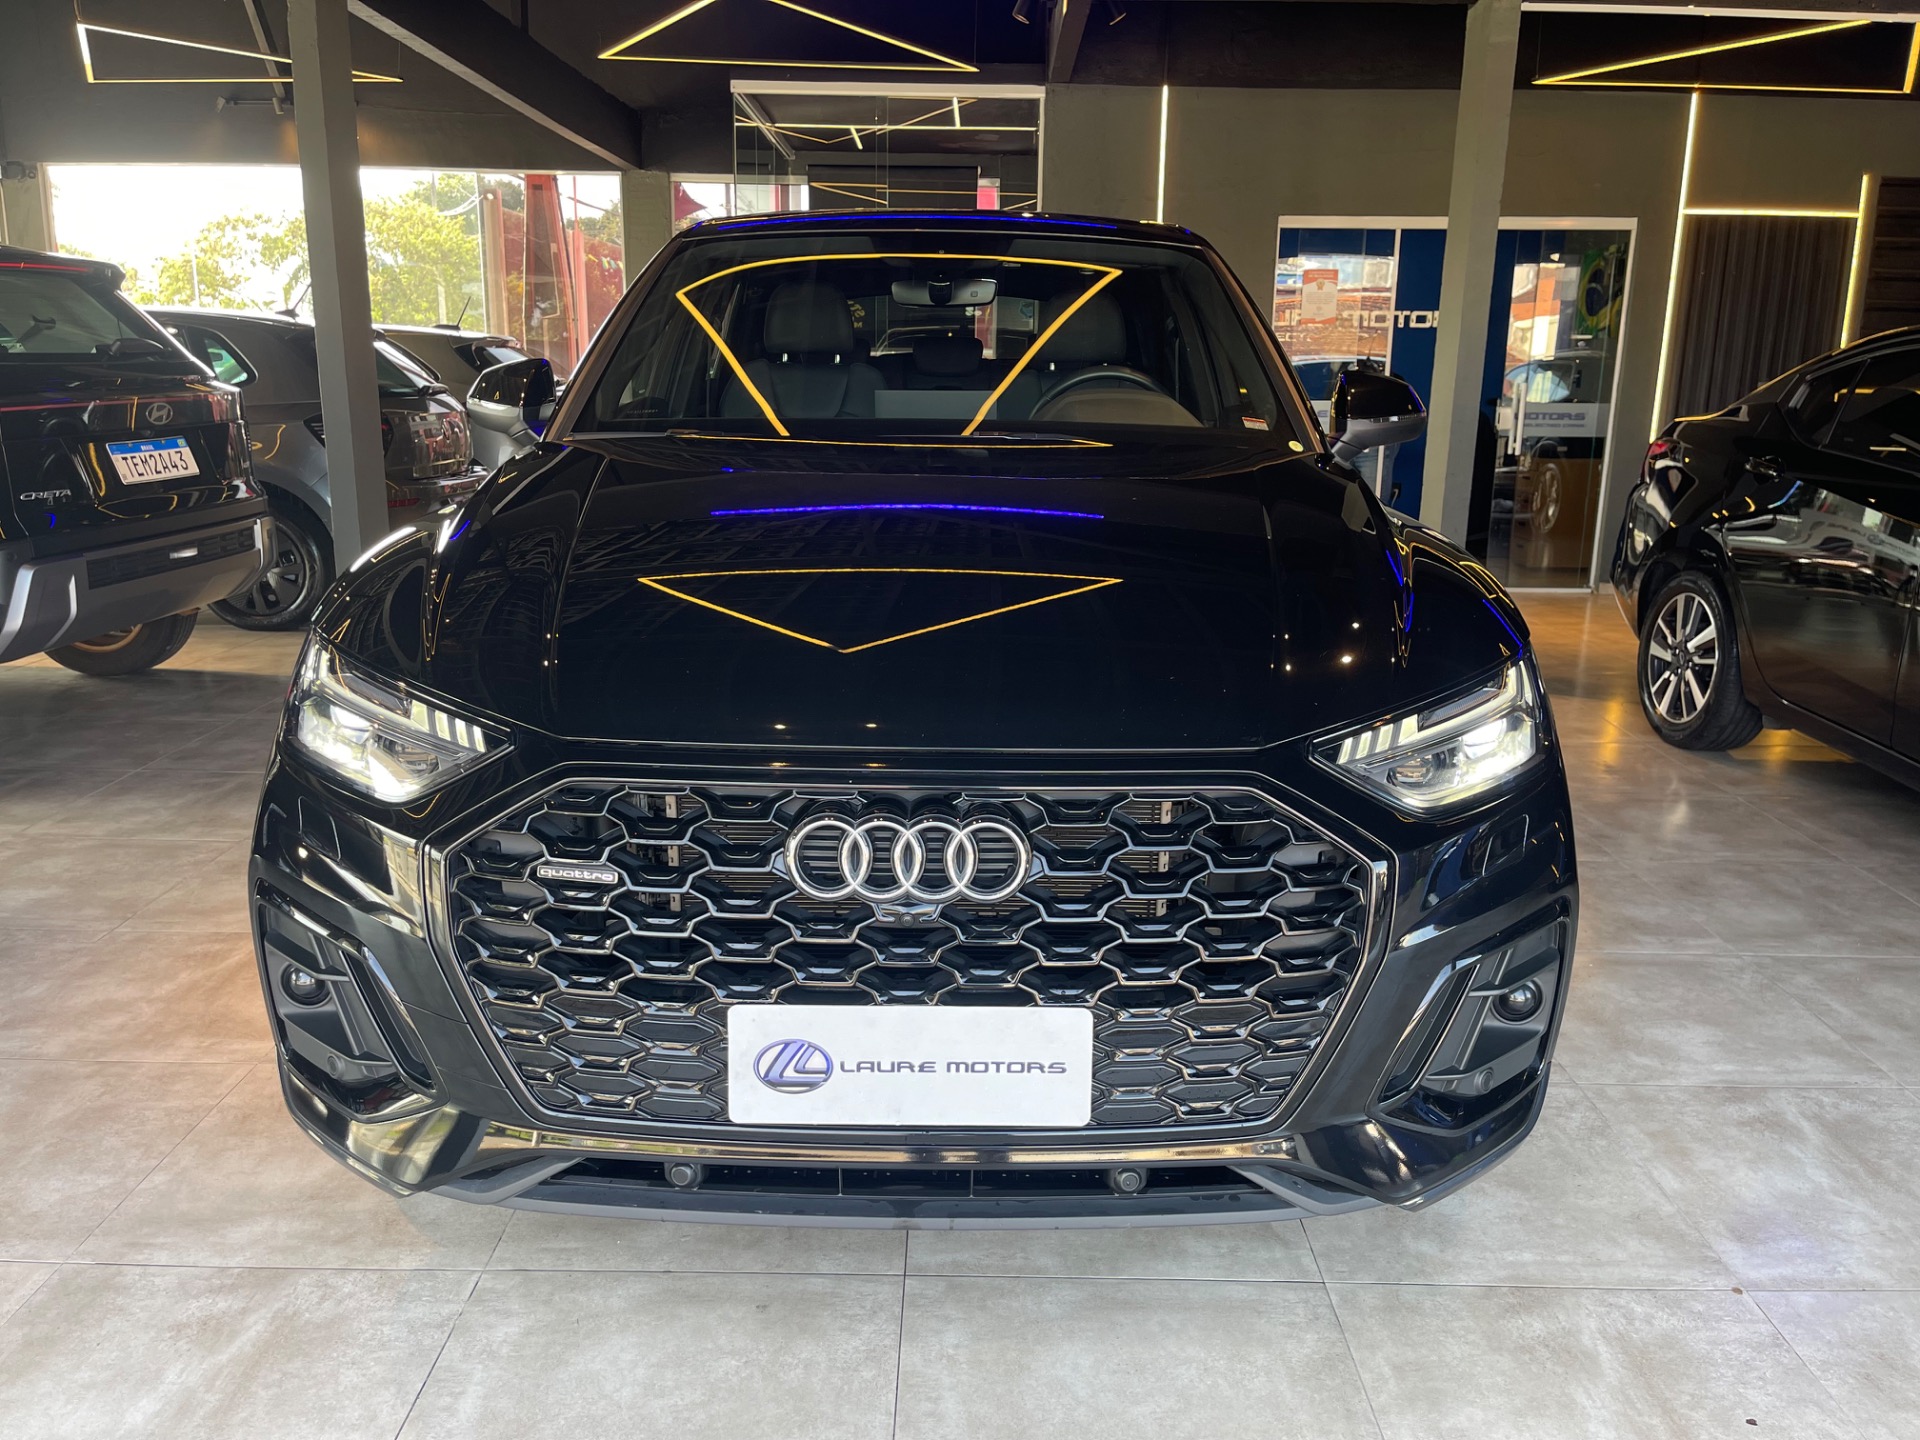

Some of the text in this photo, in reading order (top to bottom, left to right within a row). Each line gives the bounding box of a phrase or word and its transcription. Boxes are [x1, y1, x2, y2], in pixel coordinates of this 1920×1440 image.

[121, 450, 189, 479] TEM2A43
[20, 489, 71, 501] CRETA
[540, 868, 614, 881] quattro
[839, 1060, 1067, 1075] LAURE MOTORS
